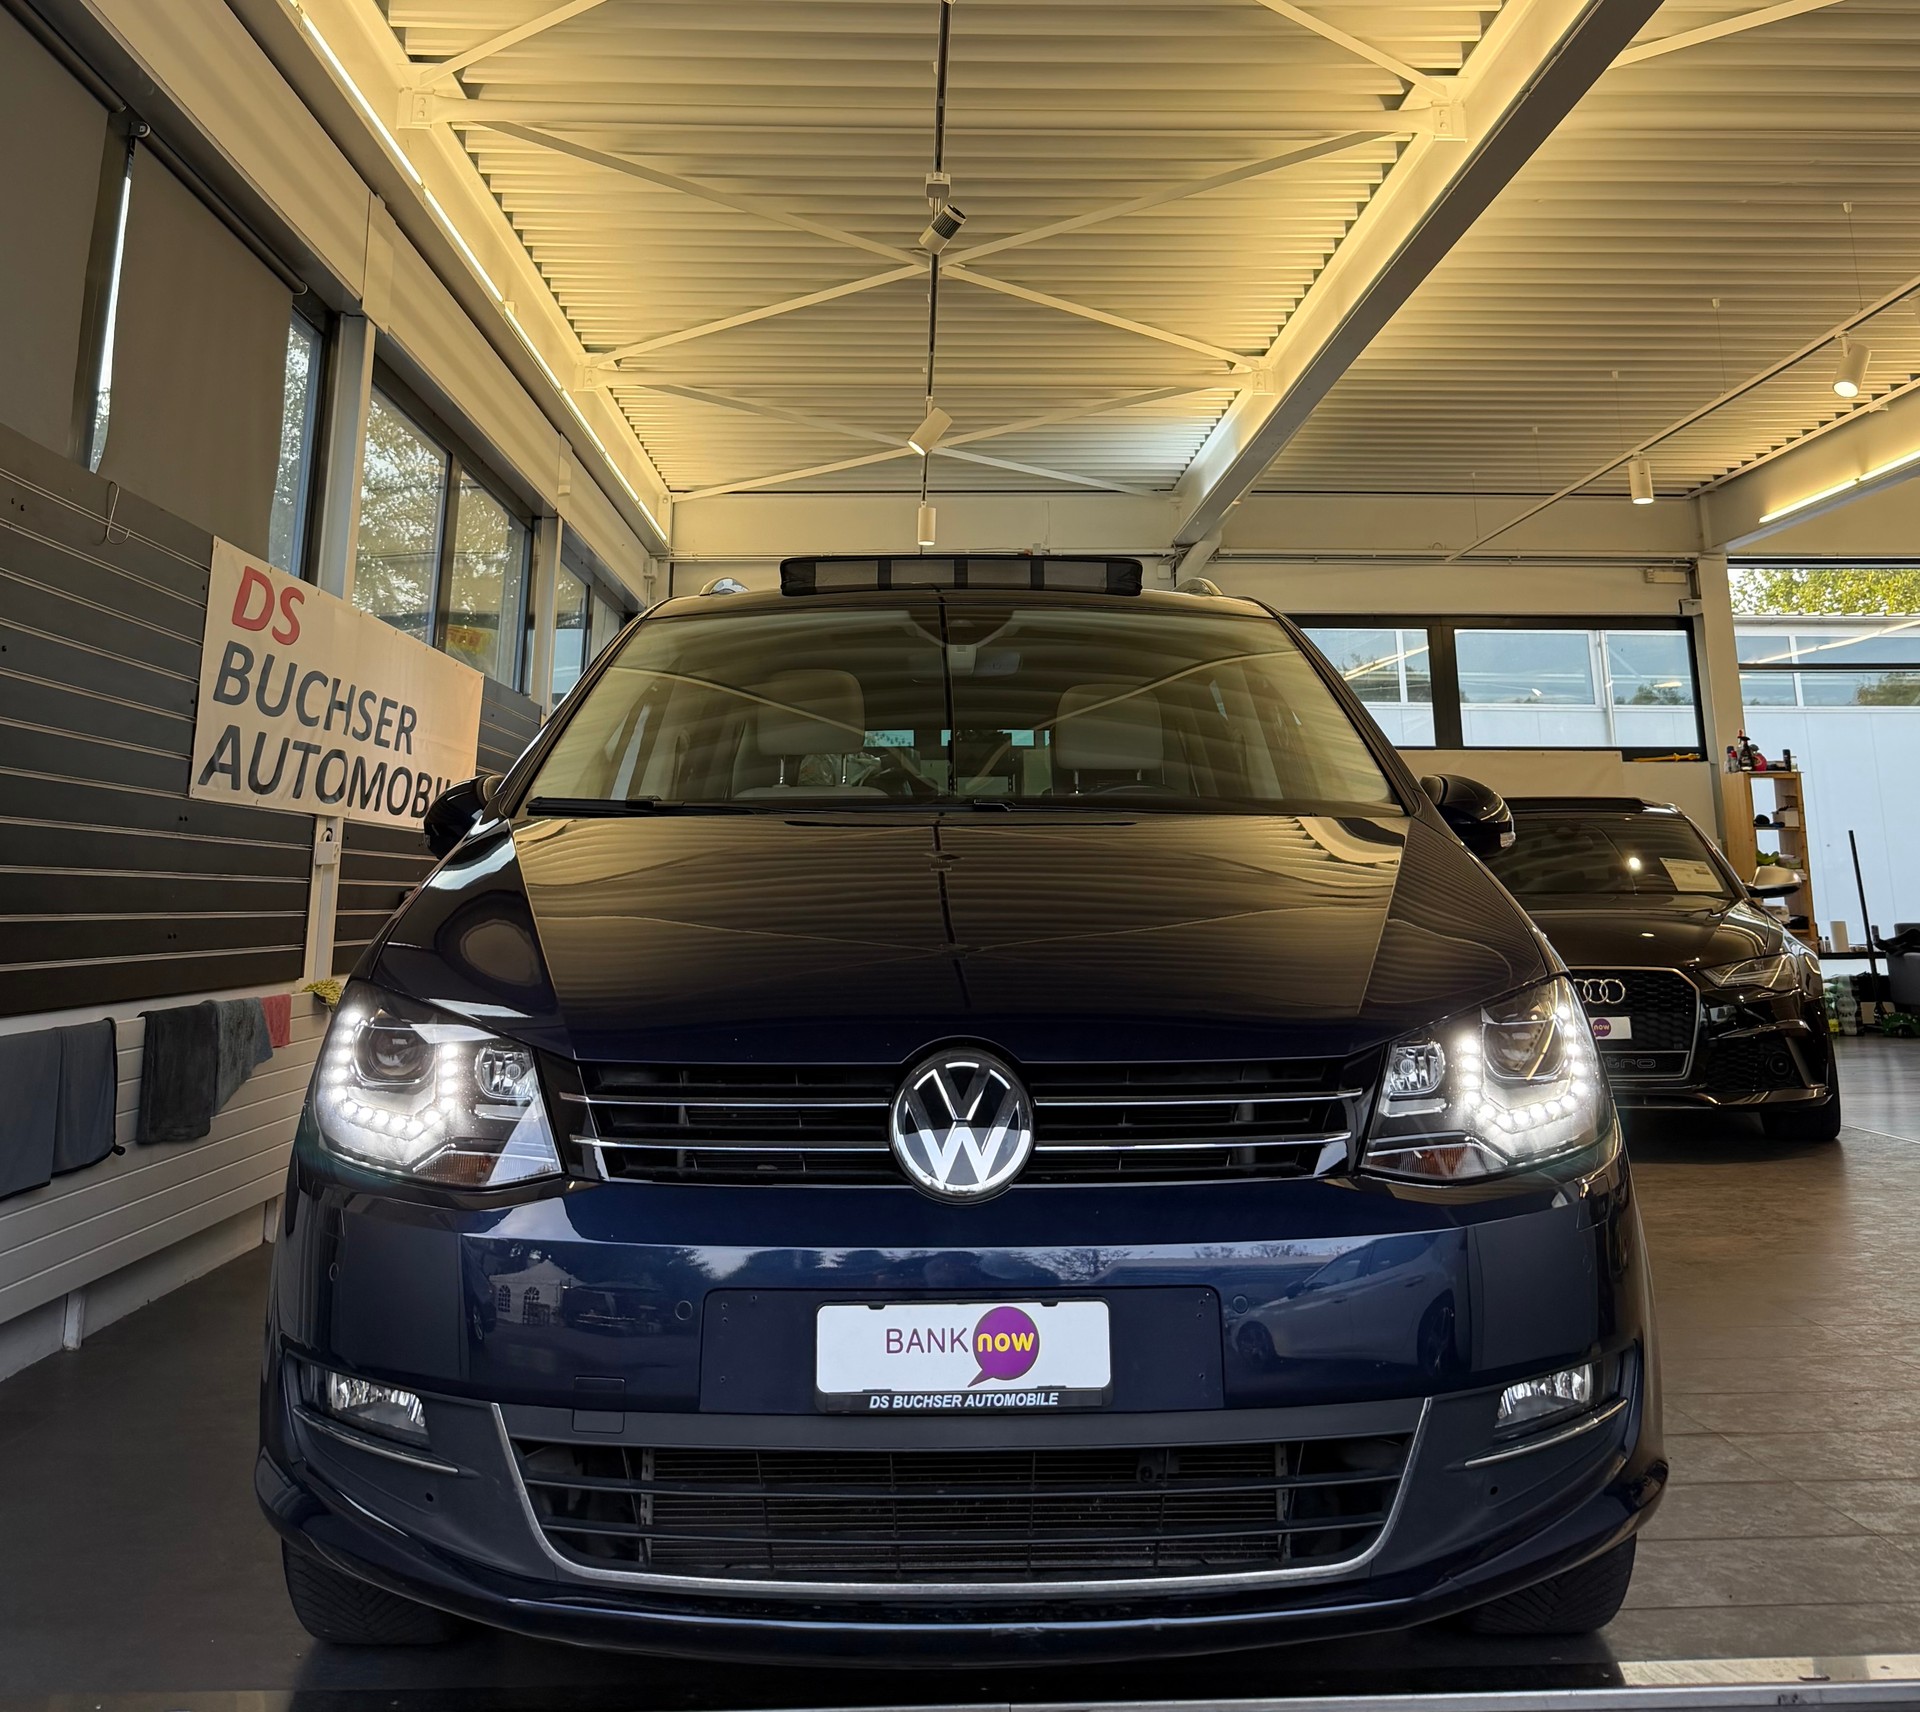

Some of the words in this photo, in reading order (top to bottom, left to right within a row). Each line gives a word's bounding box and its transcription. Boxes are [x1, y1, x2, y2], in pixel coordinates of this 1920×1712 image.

[231, 565, 305, 646] DS
[212, 640, 418, 756] BUCHSER
[198, 723, 452, 820] AUTOMOBI
[886, 1326, 969, 1354] BANK
[977, 1331, 1035, 1353] now
[869, 1394, 890, 1409] DS
[891, 1393, 962, 1409] BUCHSER
[964, 1392, 1059, 1408] AUTOMOBILE
